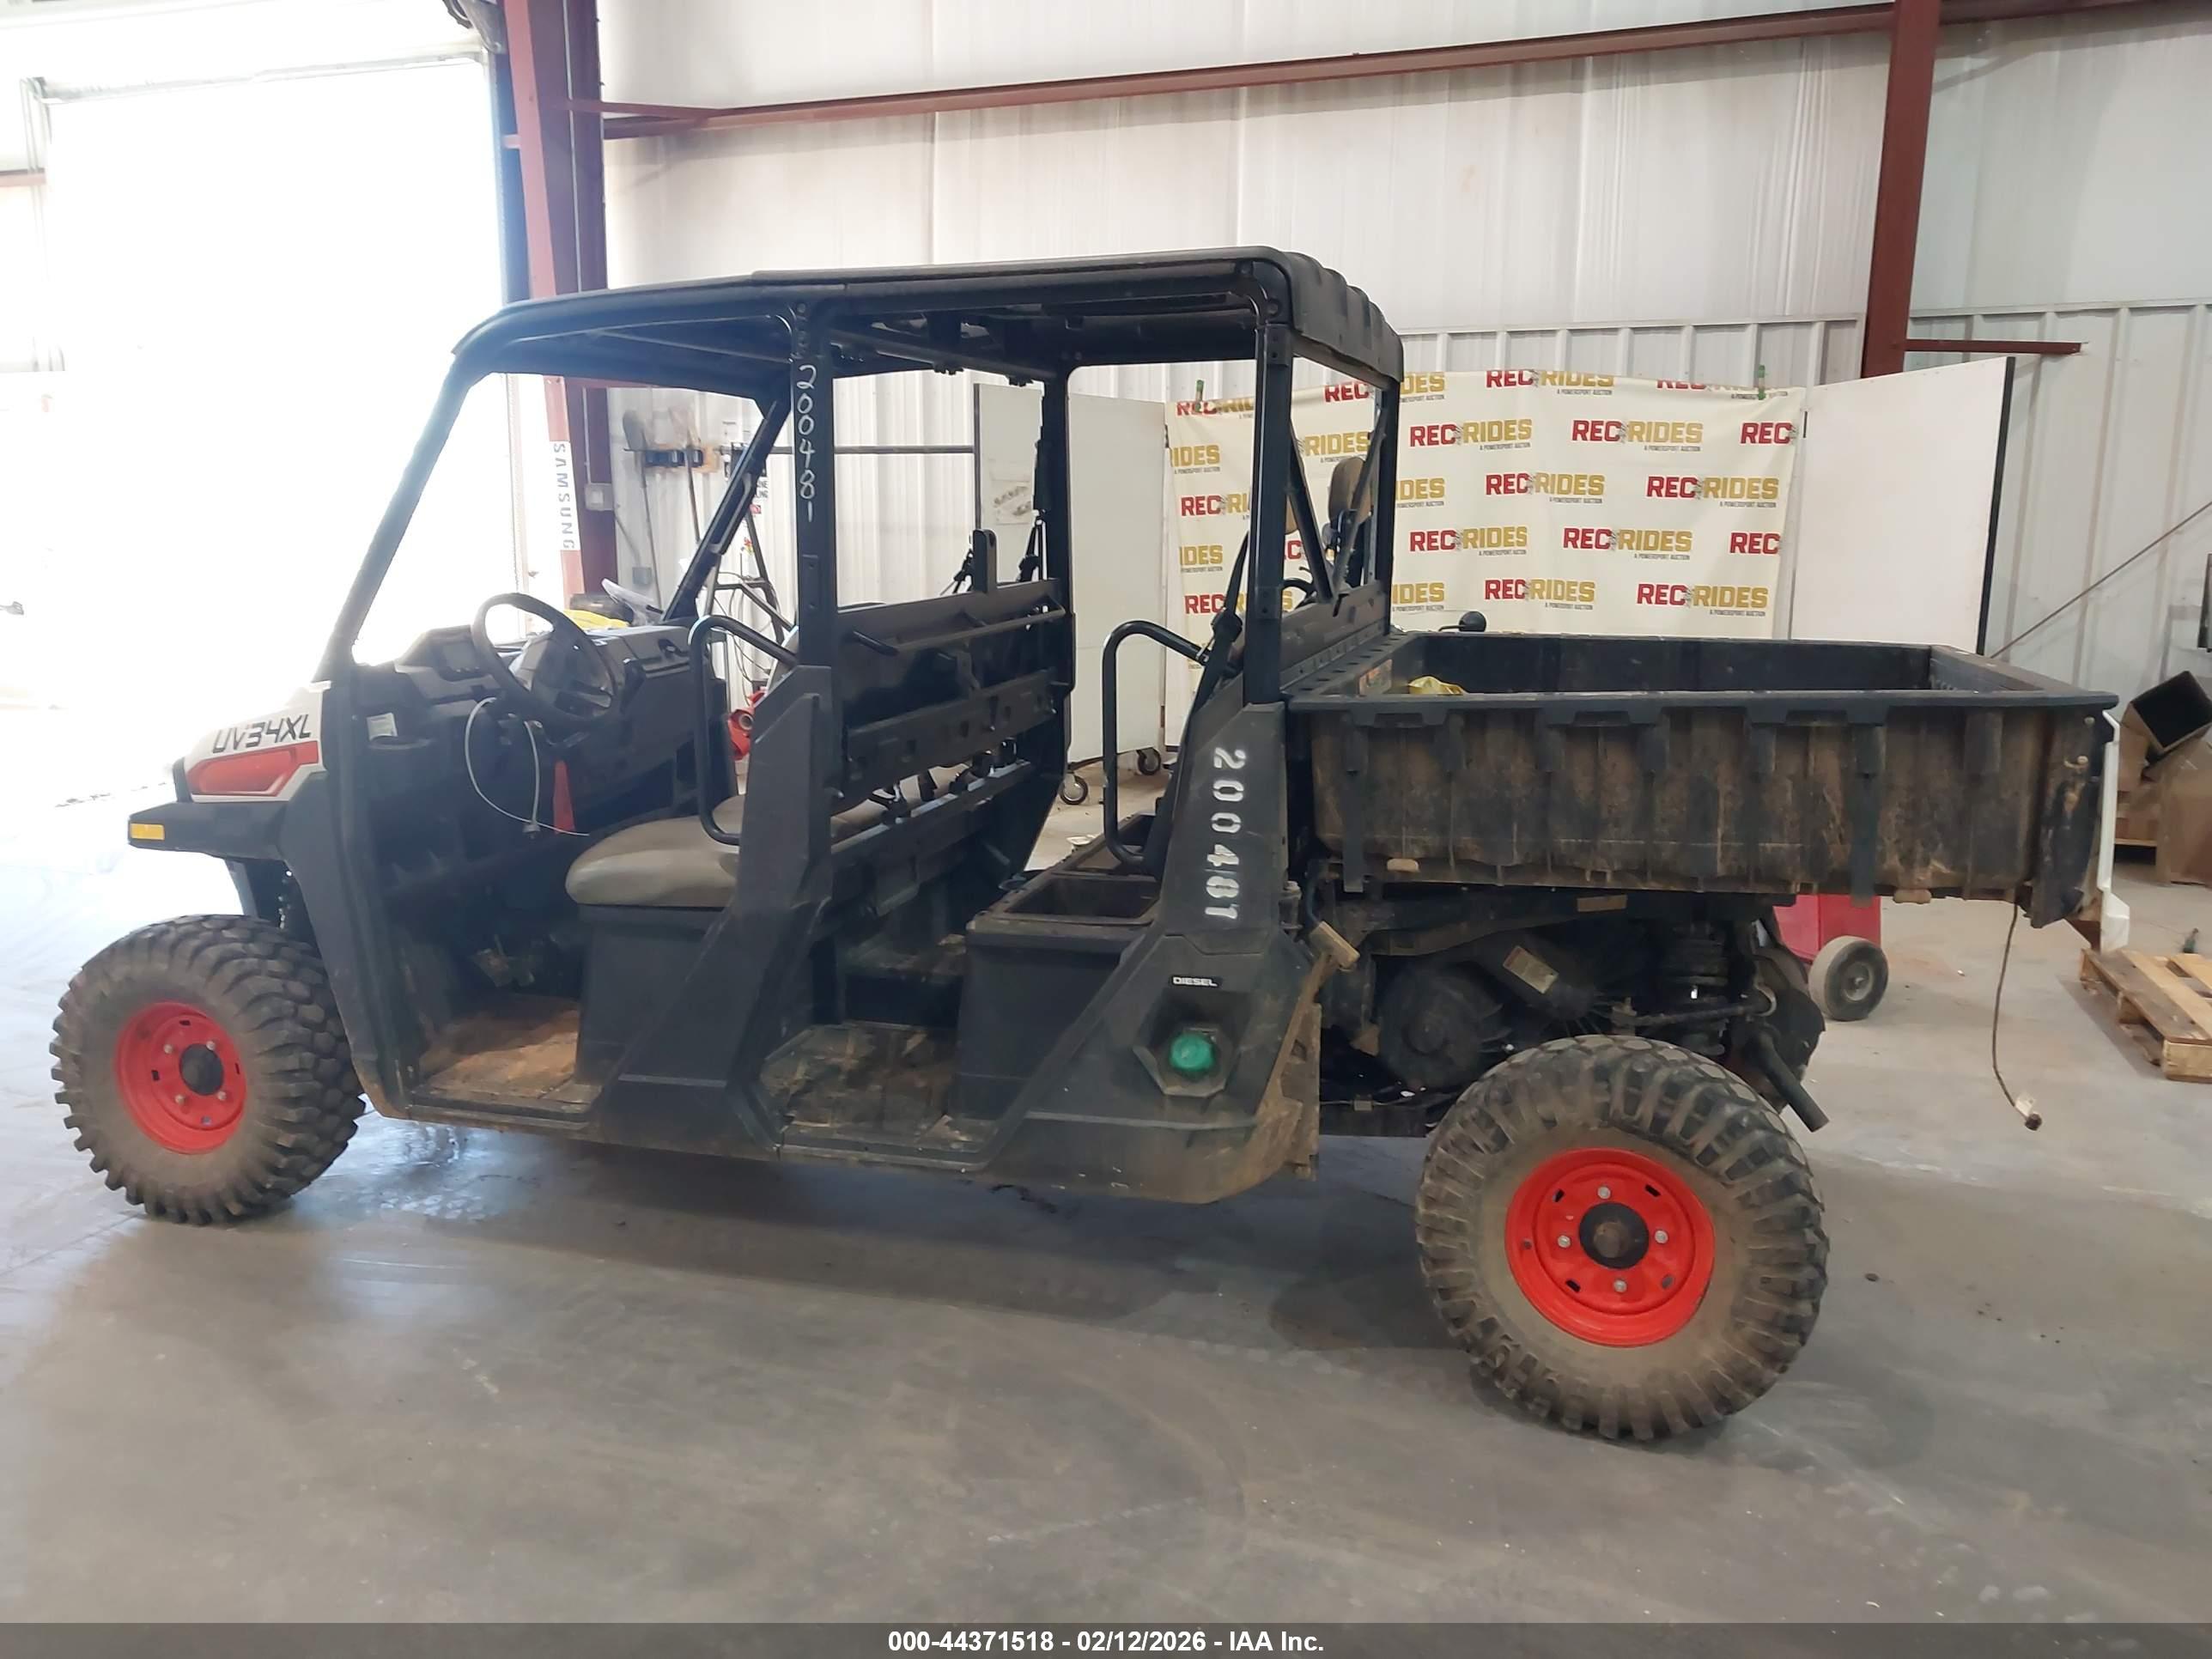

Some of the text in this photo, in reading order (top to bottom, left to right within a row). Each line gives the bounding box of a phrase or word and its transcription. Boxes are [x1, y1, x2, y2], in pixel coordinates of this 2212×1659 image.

[1401, 372, 1445, 394] DES
[1486, 370, 1614, 388] REC RIDES
[1324, 380, 1370, 403] REC
[1410, 419, 1532, 447] REC RIDES
[1572, 420, 1703, 443] REC RIDES
[1741, 422, 1792, 444] REC
[796, 364, 817, 523] 200481
[1304, 431, 1370, 456] RIDES
[1400, 477, 1445, 500] DES
[1486, 472, 1605, 495] REC RIDES
[1647, 477, 1779, 500] REC RIDES
[553, 443, 575, 549] SAMSUNG
[1182, 495, 1221, 516] REC
[1410, 526, 1528, 551] REC RIDES
[1564, 528, 1692, 552] REC RIDES
[1730, 532, 1780, 554] REC
[1392, 582, 1444, 604] IDES
[1485, 580, 1595, 603] REC RIDES
[1637, 584, 1769, 608] REC RIDES
[1185, 594, 1224, 614] REC
[213, 714, 312, 754] UV34XL
[1205, 747, 1247, 920] 200481
[1173, 976, 1218, 988] DIESEL
